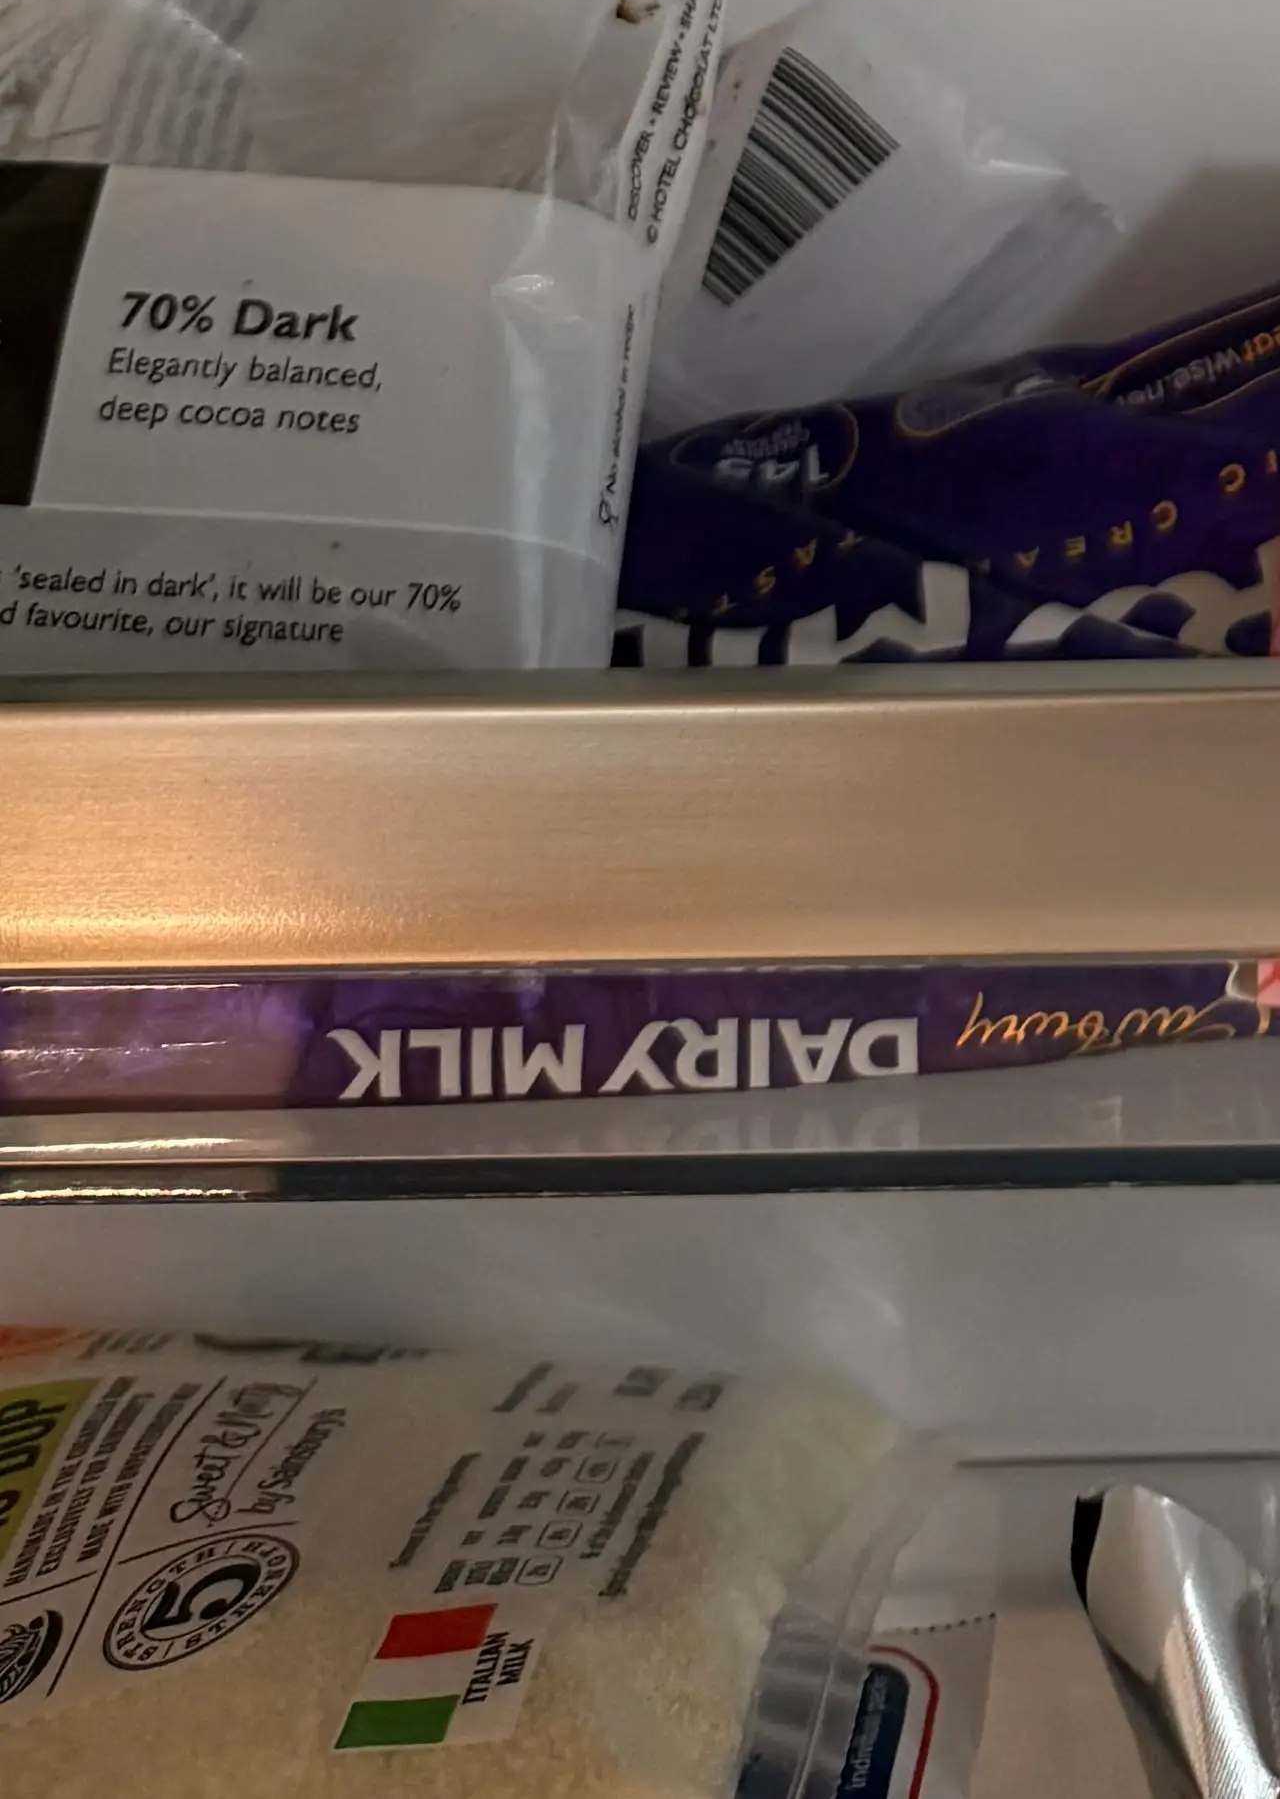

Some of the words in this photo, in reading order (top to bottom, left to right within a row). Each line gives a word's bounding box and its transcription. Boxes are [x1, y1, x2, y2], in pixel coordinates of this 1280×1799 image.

[651, 155, 682, 224] HOTEL
[121, 290, 217, 333] 70%
[233, 297, 360, 342] Dark
[107, 347, 238, 389] Elegantly
[249, 355, 383, 393] balanced,
[98, 395, 169, 430] deep
[179, 403, 266, 427] cocoa
[277, 409, 361, 433] notes
[112, 568, 138, 595] in
[228, 574, 248, 600] it
[258, 575, 302, 602] will
[311, 577, 342, 605] be
[350, 585, 397, 607] our
[405, 582, 462, 613] 70%
[26, 602, 155, 638] favourite,
[165, 613, 215, 637] our
[223, 613, 345, 648] signature
[325, 1023, 586, 1100] MILK
[598, 1016, 919, 1092] DAIRY
[139, 1562, 262, 1633] 5
[462, 1629, 507, 1706] ITALIAN
[495, 1637, 534, 1687] MILK
